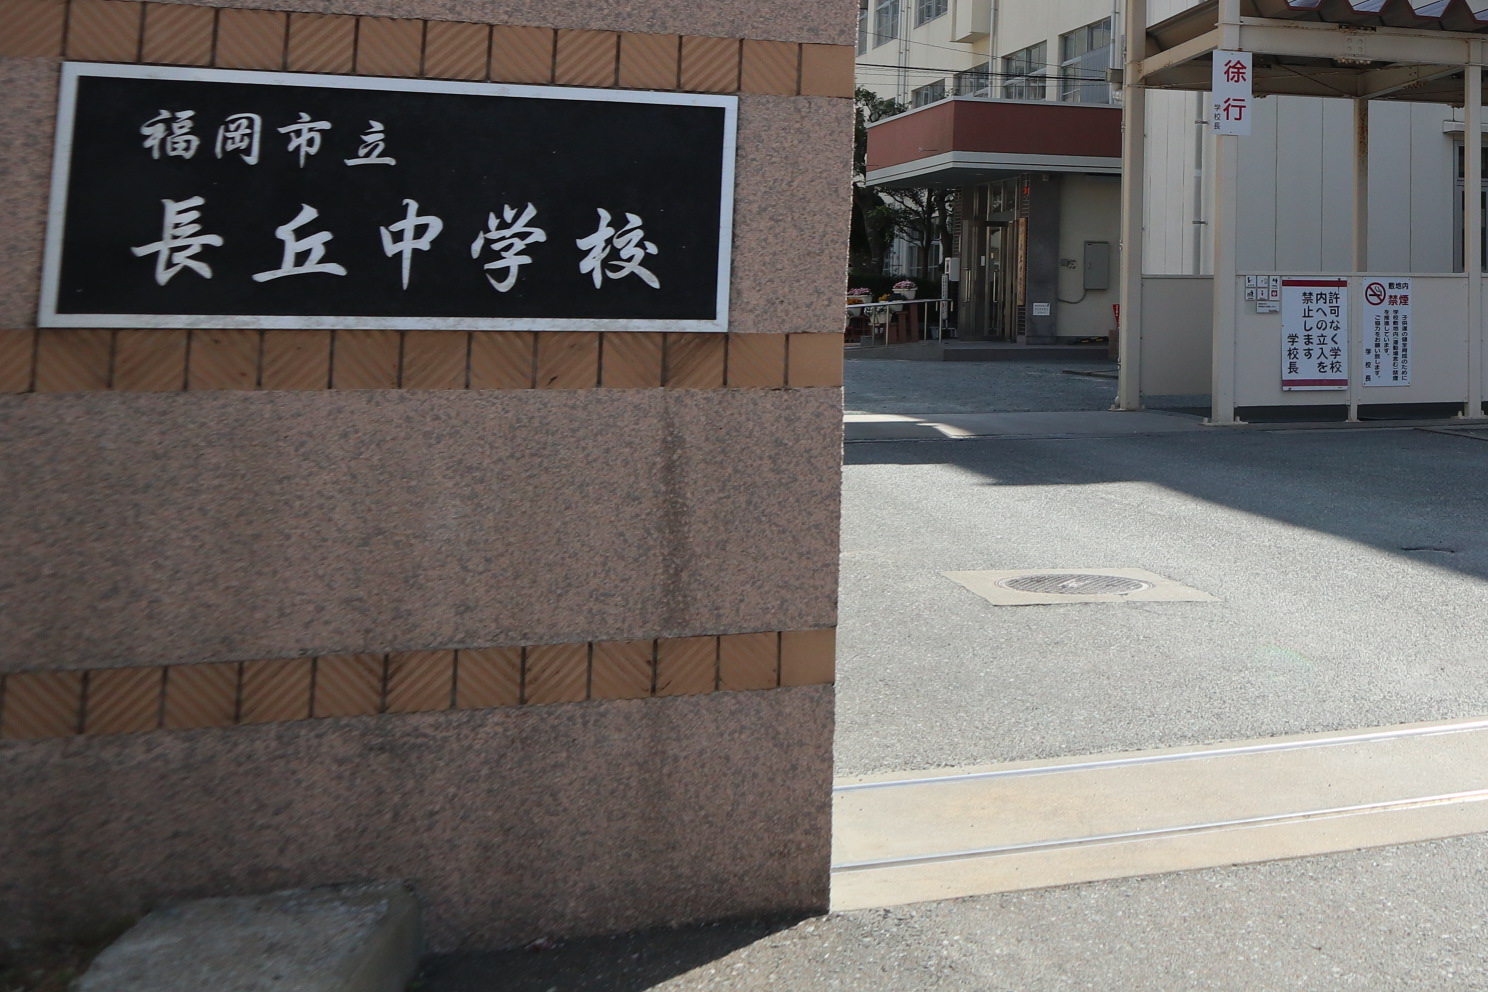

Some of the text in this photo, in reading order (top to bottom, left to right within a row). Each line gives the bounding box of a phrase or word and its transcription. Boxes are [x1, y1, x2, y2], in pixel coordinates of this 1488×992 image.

[1213, 104, 1221, 130] 学校長
[1223, 59, 1247, 121] 徐行
[140, 109, 398, 168] 福岡市立
[130, 195, 662, 293] 長丘中学校
[1388, 282, 1409, 290] 敷地内
[1388, 294, 1409, 306] 禁煙
[1287, 333, 1299, 374] 学校長
[1302, 291, 1314, 360] 禁止します
[1315, 291, 1328, 374] 内への立入を
[1328, 291, 1342, 374] 許可なく学校
